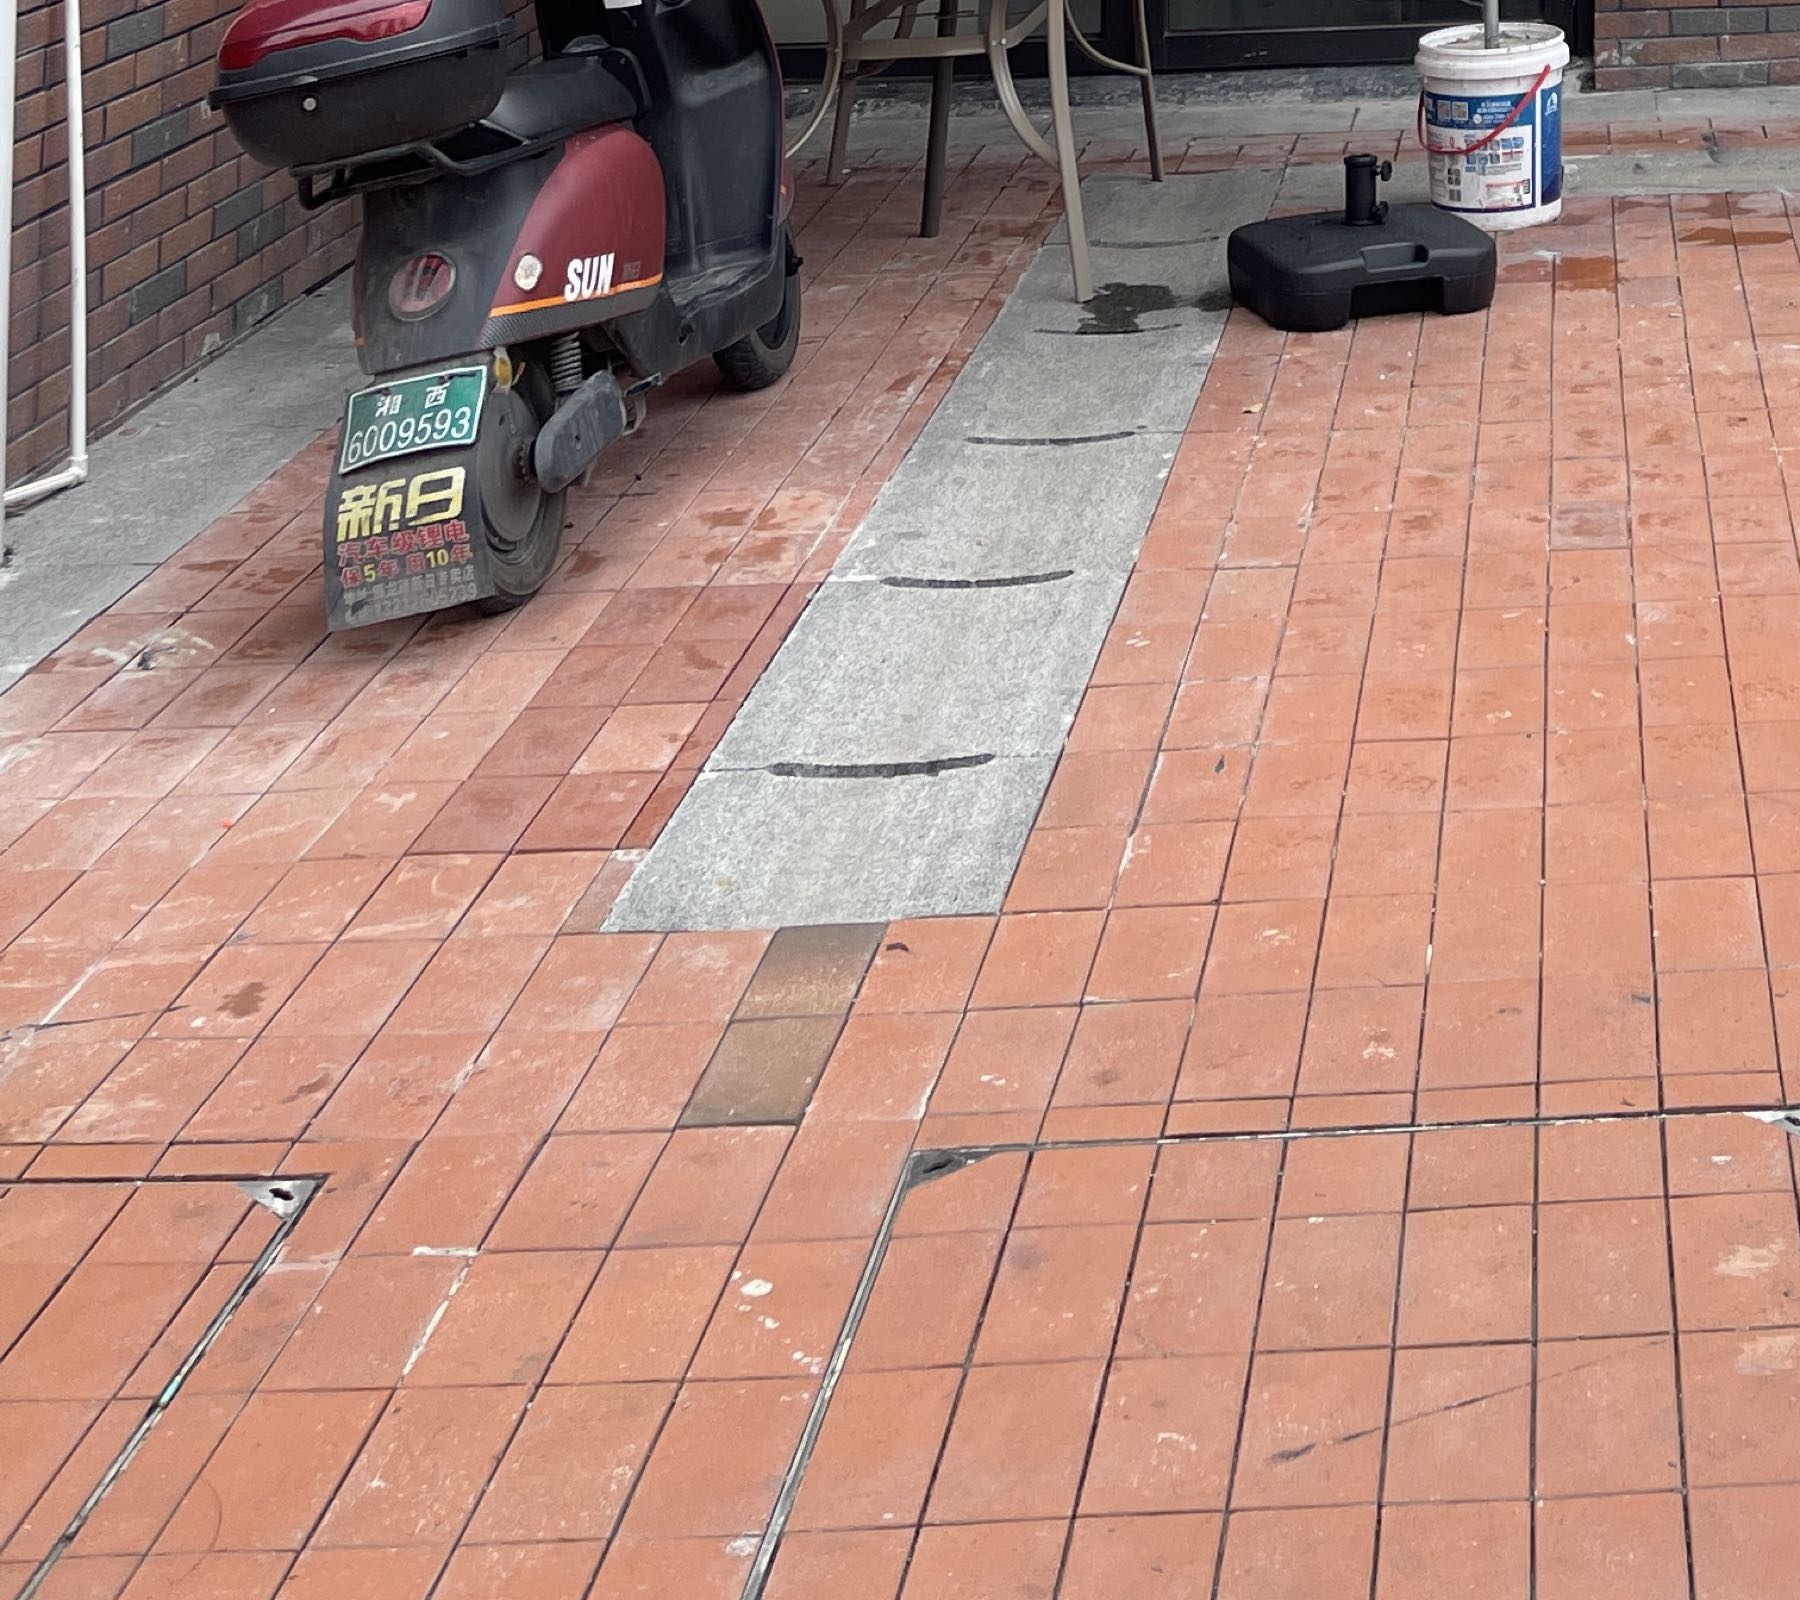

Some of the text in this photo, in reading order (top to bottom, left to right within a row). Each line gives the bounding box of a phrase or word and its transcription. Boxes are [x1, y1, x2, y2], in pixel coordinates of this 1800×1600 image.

[564, 252, 614, 302] SUN
[348, 406, 471, 463] 6009593
[337, 466, 466, 542] 新日
